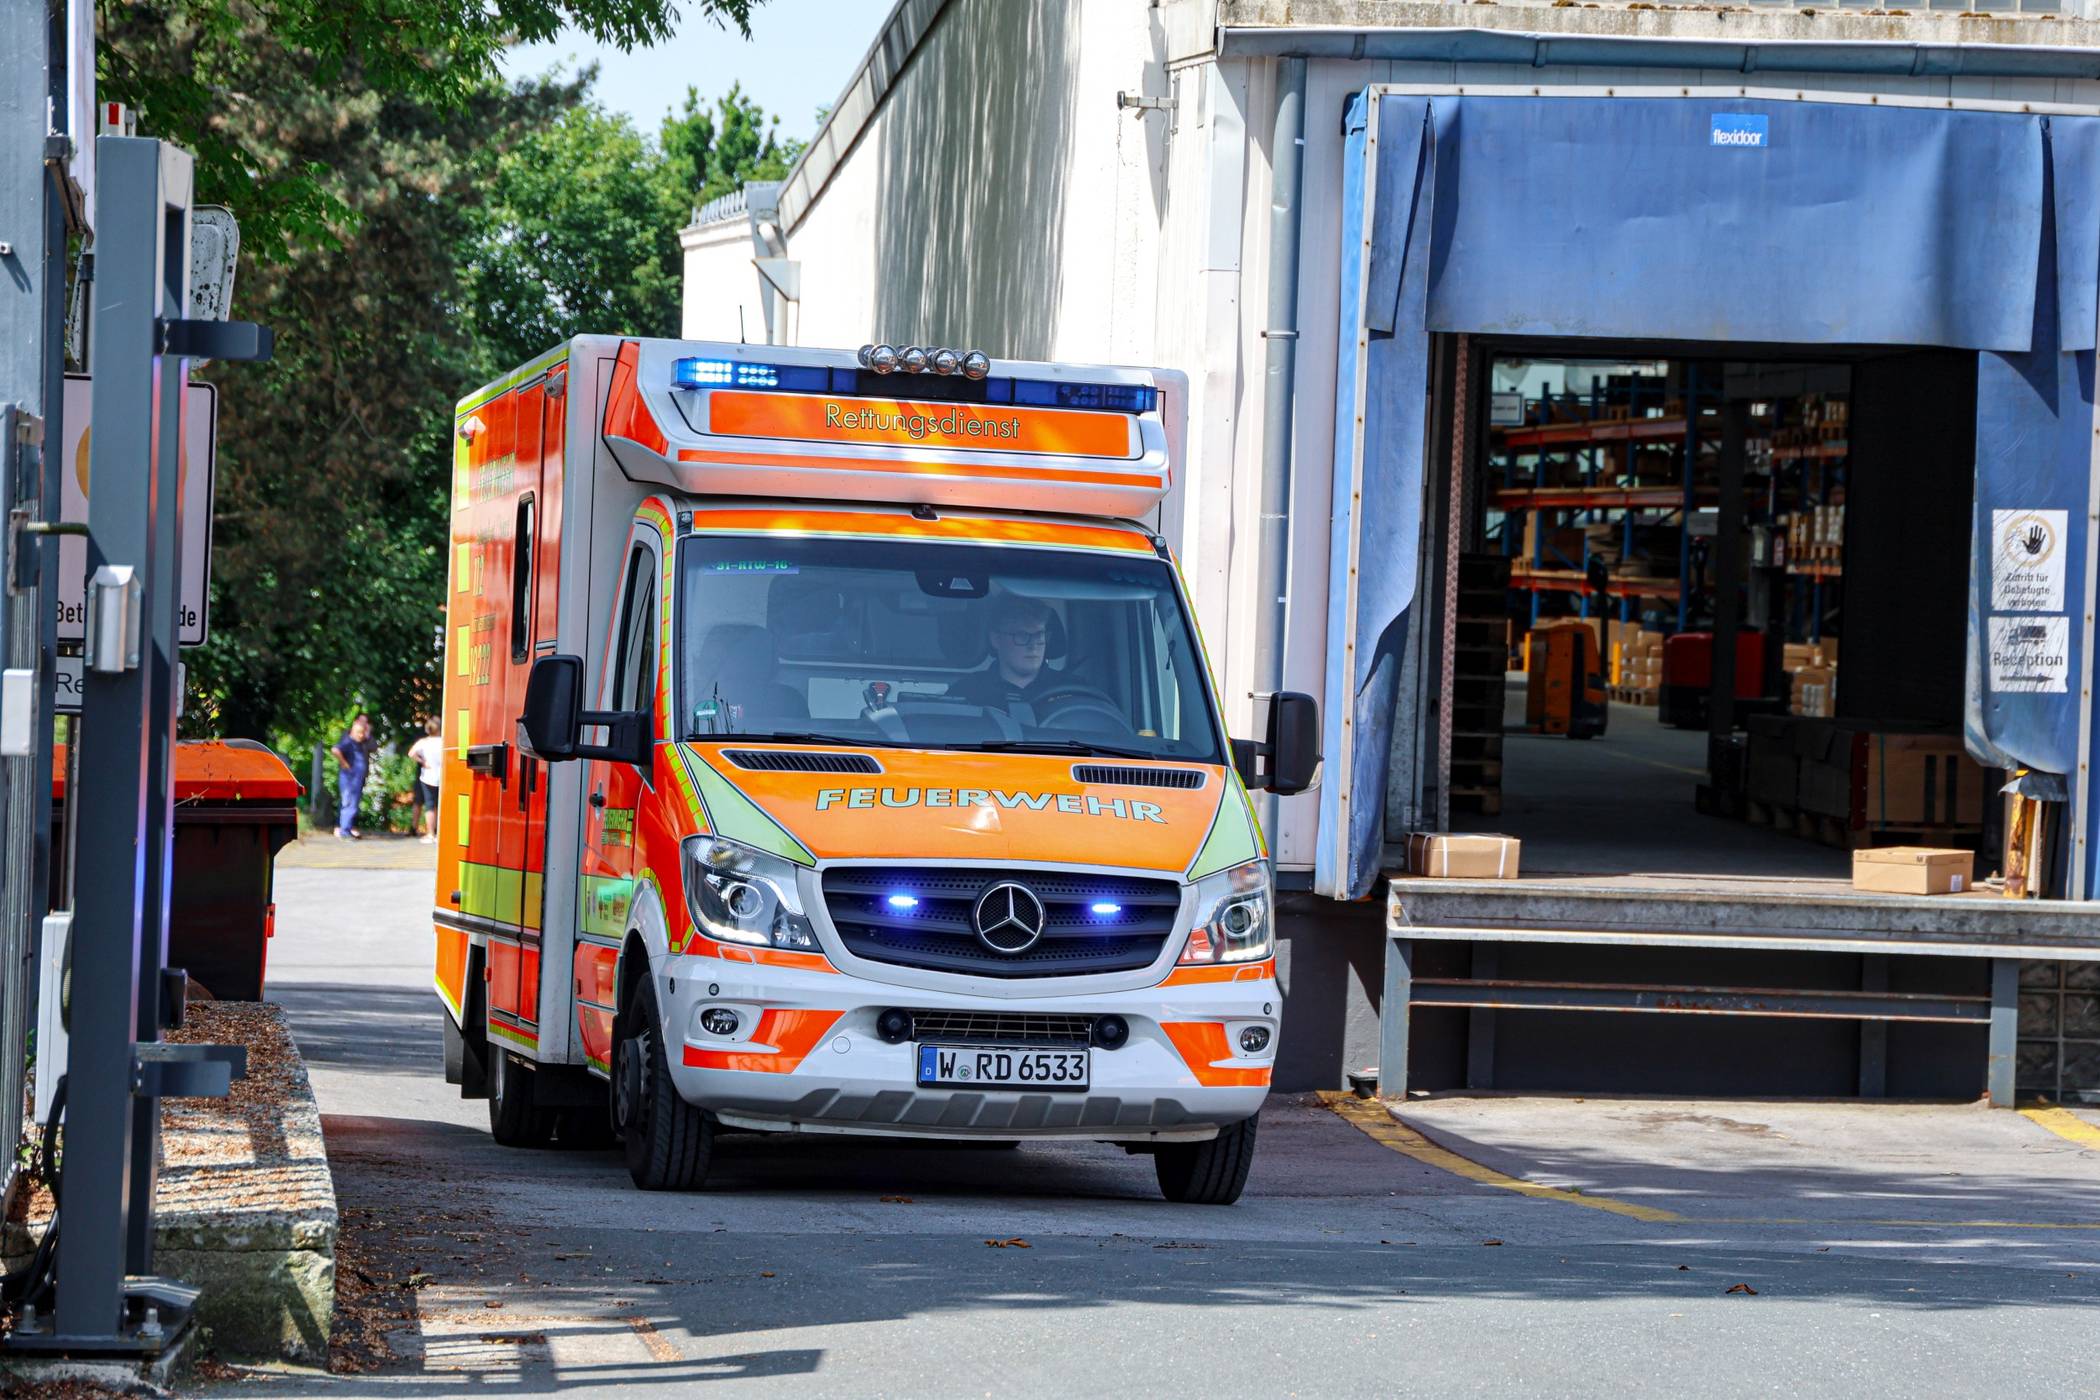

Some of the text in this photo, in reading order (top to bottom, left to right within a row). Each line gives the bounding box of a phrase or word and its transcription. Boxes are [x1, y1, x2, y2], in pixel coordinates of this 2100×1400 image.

[1713, 129, 1762, 145] flexidoor
[826, 403, 1020, 439] Rettungsdienst
[1993, 652, 2063, 669] Reception
[816, 788, 1168, 824] FEUERWEHR
[939, 1052, 1084, 1081] W RD 6533
